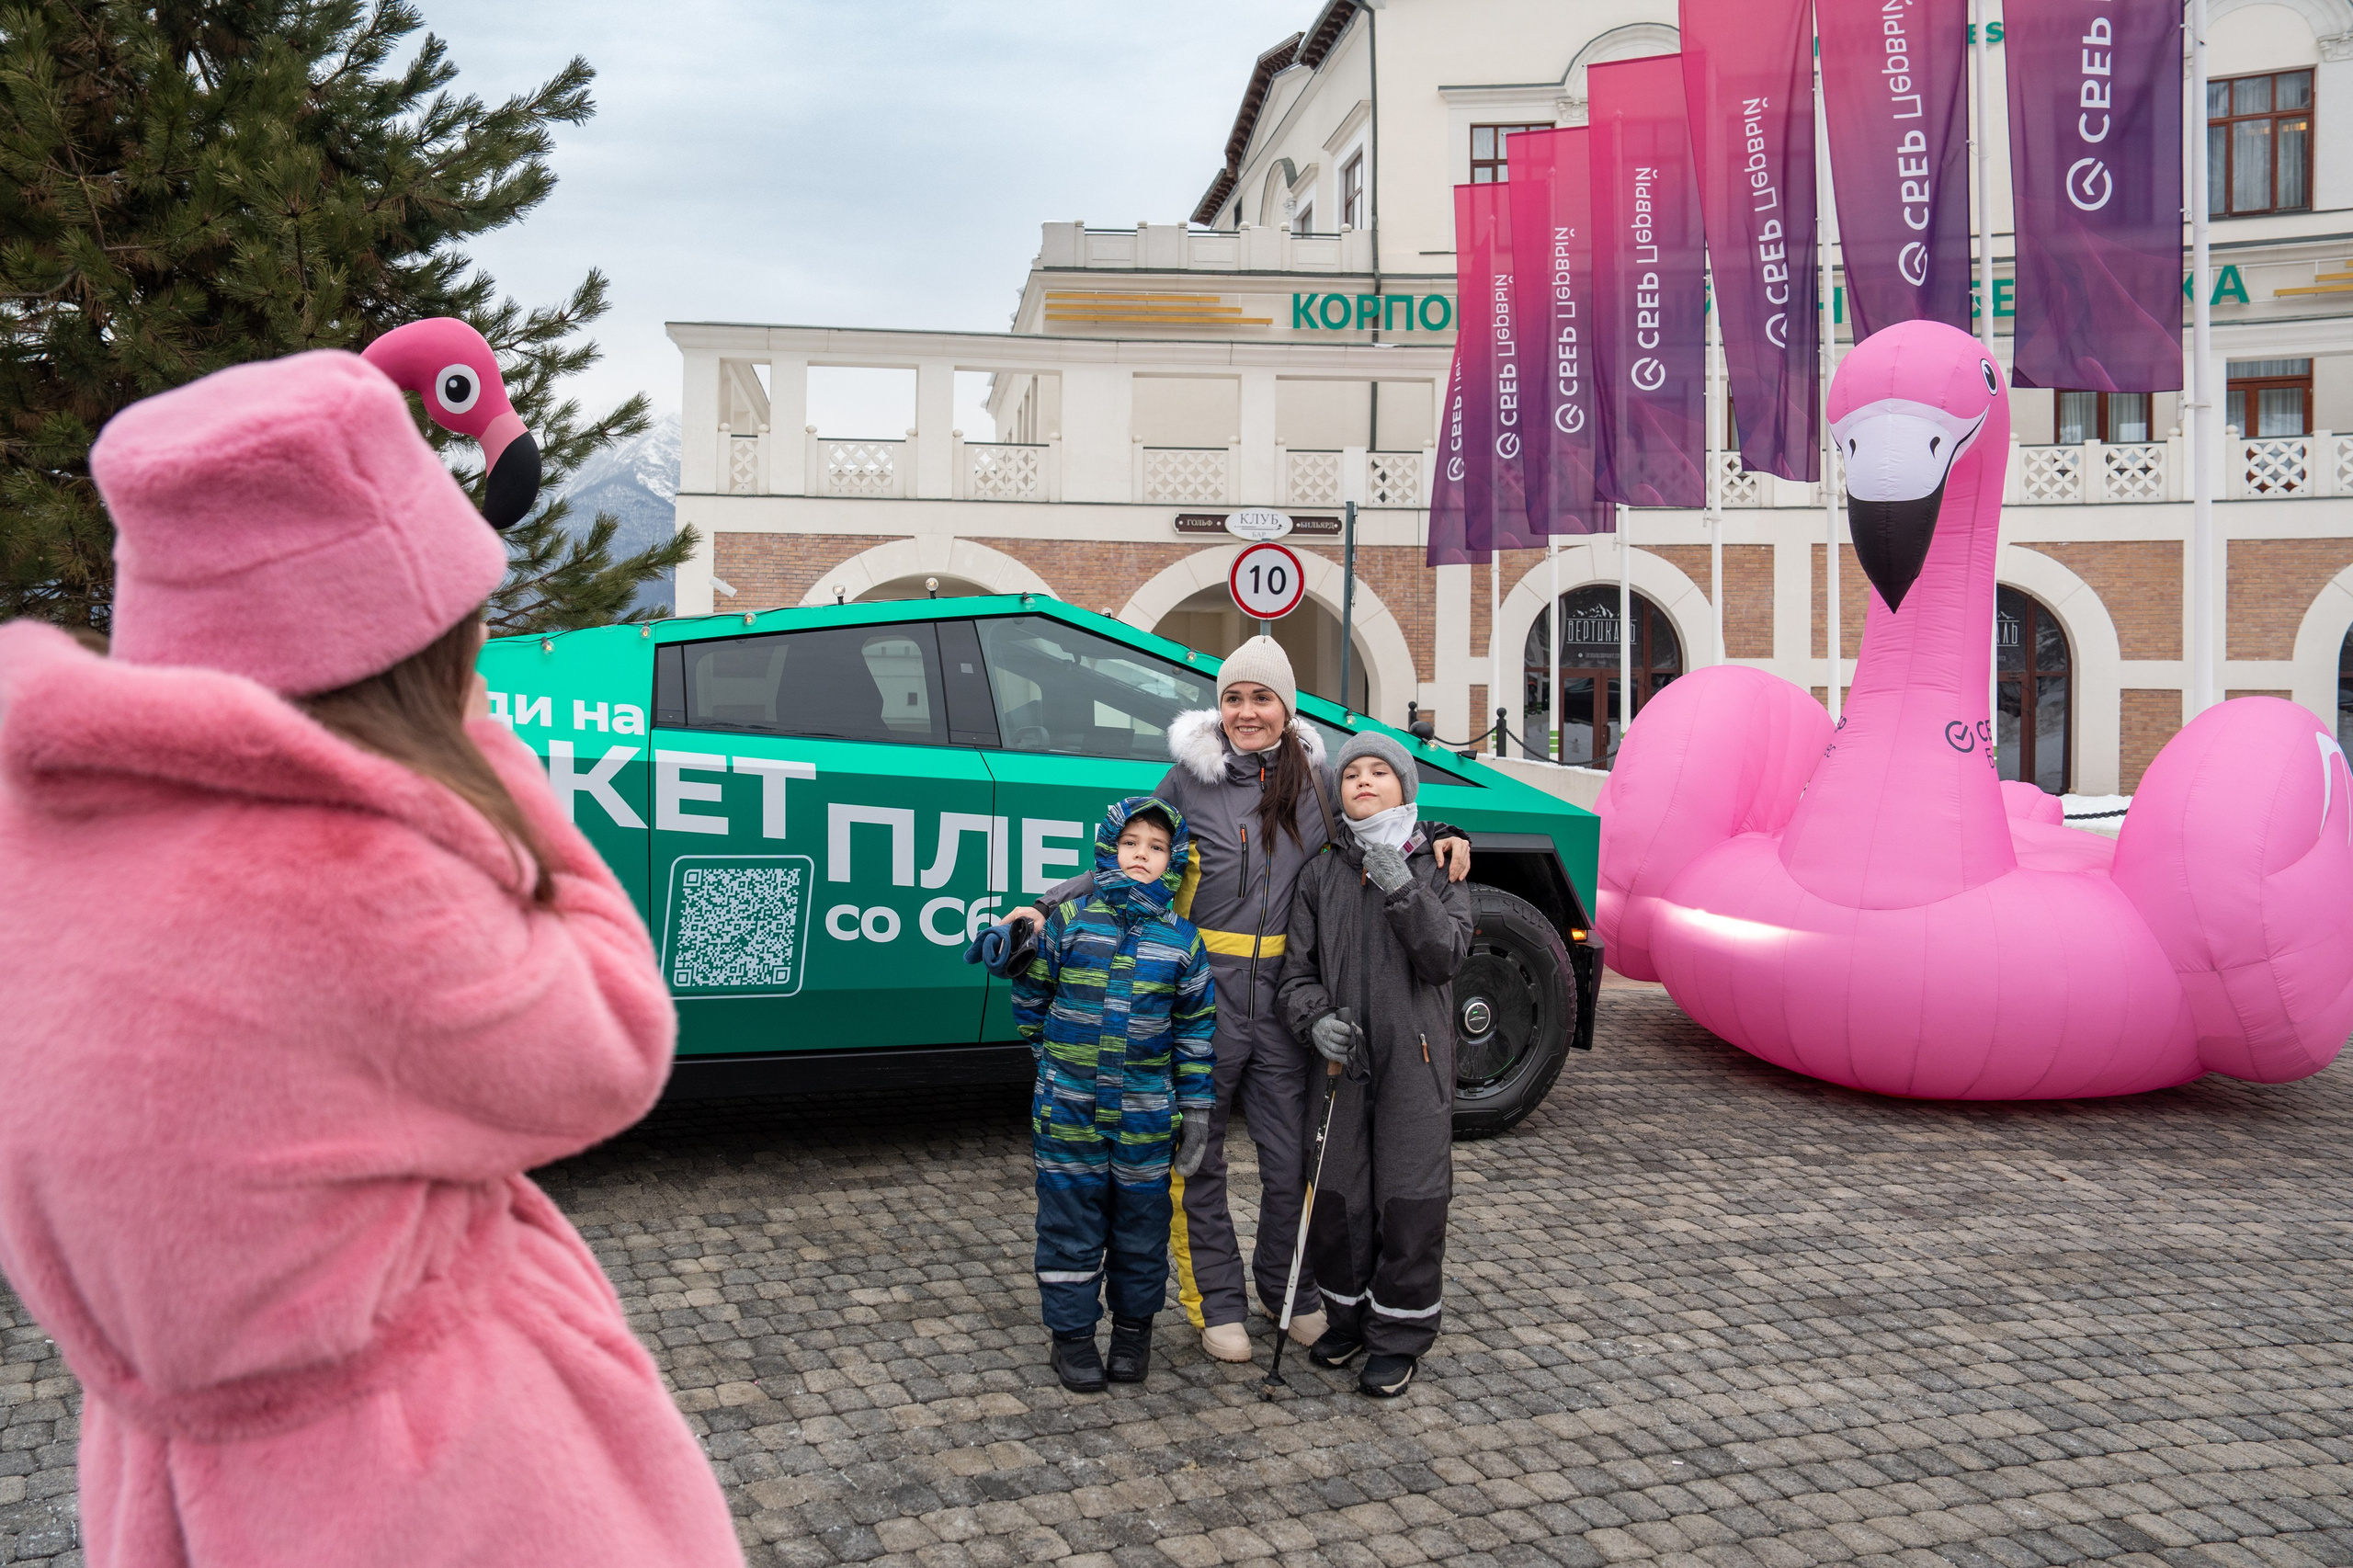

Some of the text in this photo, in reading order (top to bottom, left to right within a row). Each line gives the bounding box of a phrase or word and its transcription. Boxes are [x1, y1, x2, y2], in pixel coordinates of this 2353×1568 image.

[1292, 293, 1459, 331] КОРПО
[1240, 513, 1279, 525] КЛУБ
[1300, 521, 1335, 530] БИЛЬЯРД
[1249, 565, 1287, 596] 10
[1567, 620, 1636, 642] ВЕРТИКАЬ
[574, 699, 645, 735] на
[524, 739, 816, 840] КЕТ
[828, 802, 1103, 893] ПЛЕ
[825, 904, 901, 943] со
